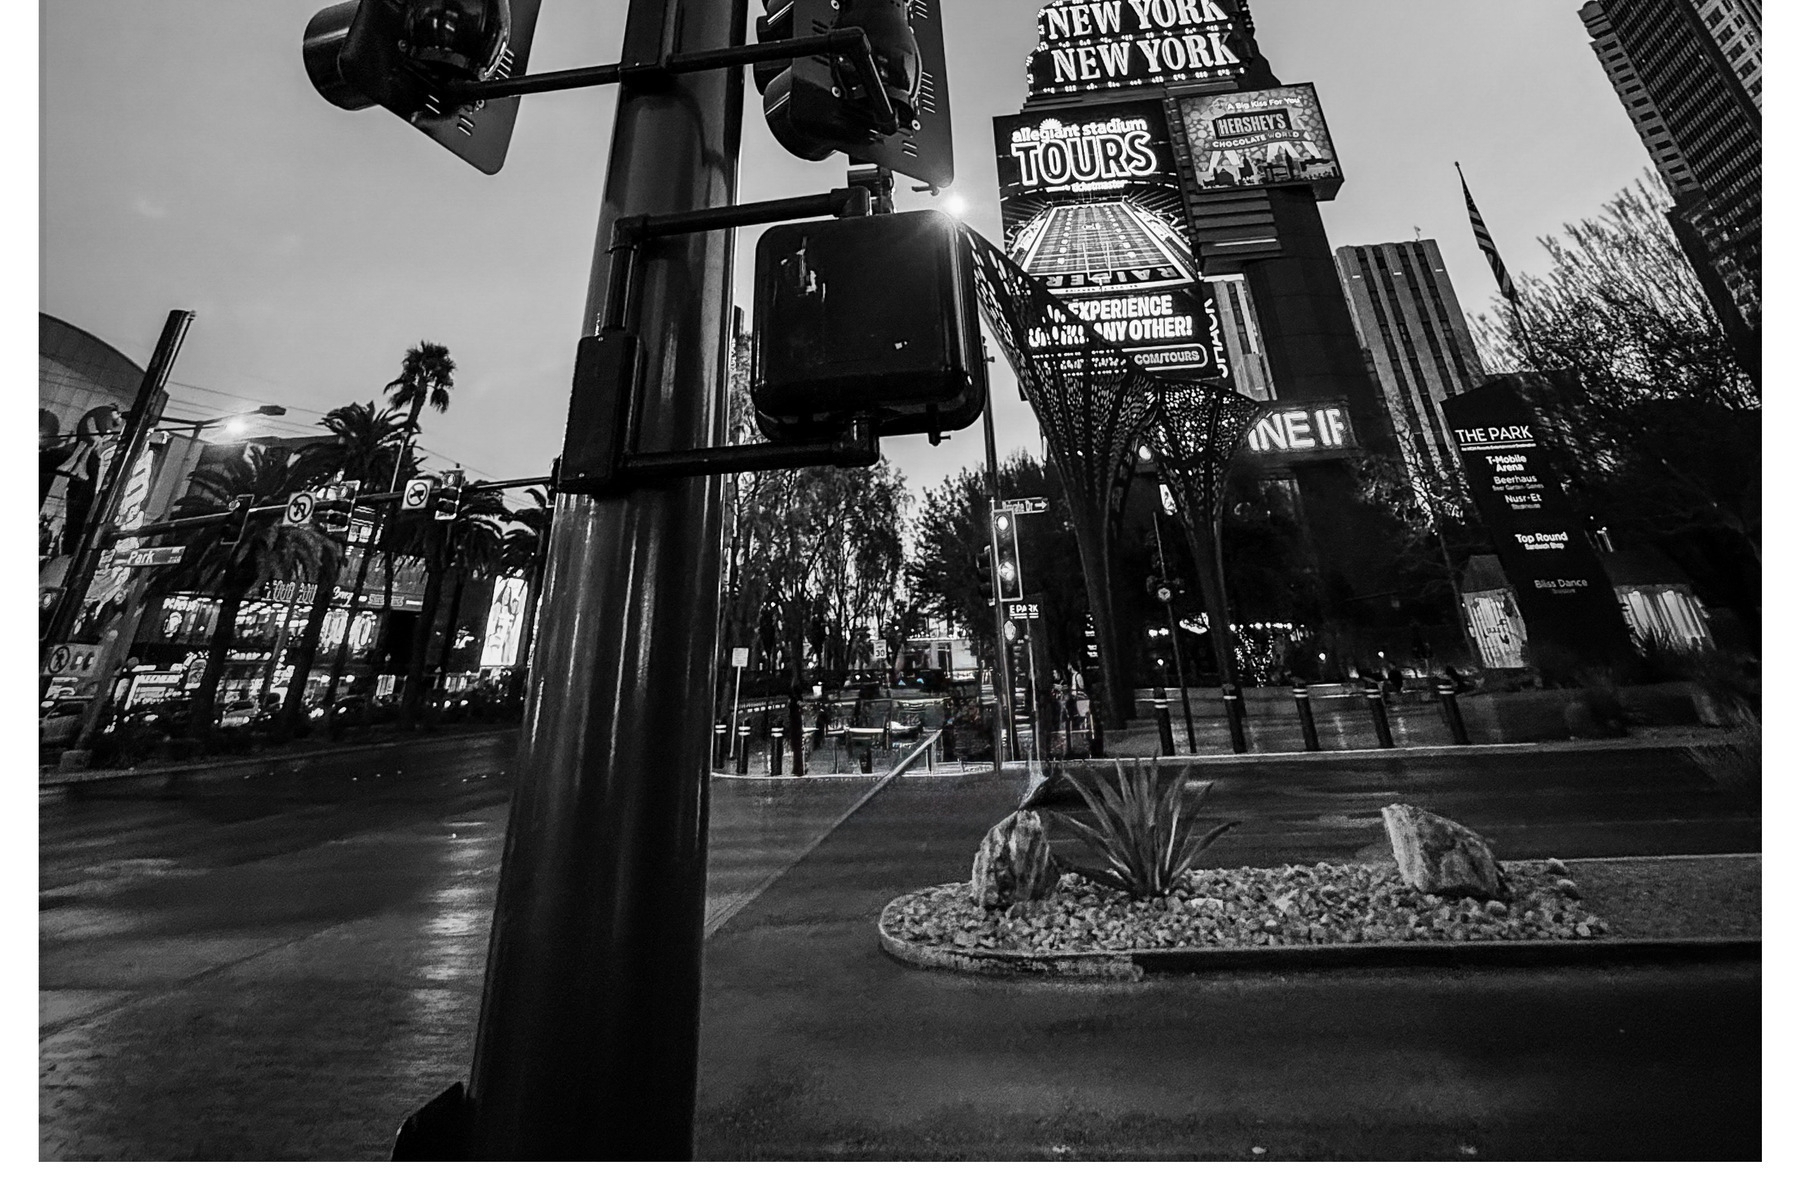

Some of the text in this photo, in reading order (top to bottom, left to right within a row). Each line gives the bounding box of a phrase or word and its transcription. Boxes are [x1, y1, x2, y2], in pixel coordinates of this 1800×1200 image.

[1046, 0, 1122, 40] NEW
[1051, 32, 1240, 83] NEW YORK
[1236, 102, 1250, 110] Big
[1251, 99, 1268, 108] Kiss
[1269, 98, 1283, 106] For
[1011, 117, 1148, 143] allegiant stadium
[1217, 113, 1286, 137] HERSHEY'S
[1212, 131, 1300, 148] CHOCOLATE WORLD
[1010, 130, 1158, 187] TOURS
[1128, 315, 1193, 341] OTHER!
[1454, 425, 1533, 443] THE PARK
[1496, 463, 1524, 472] Arena
[1493, 475, 1538, 485] Beerhaus
[1514, 531, 1569, 544] Top Round
[127, 550, 155, 565] Park
[1557, 578, 1589, 588] Dance
[876, 649, 885, 657] 30
